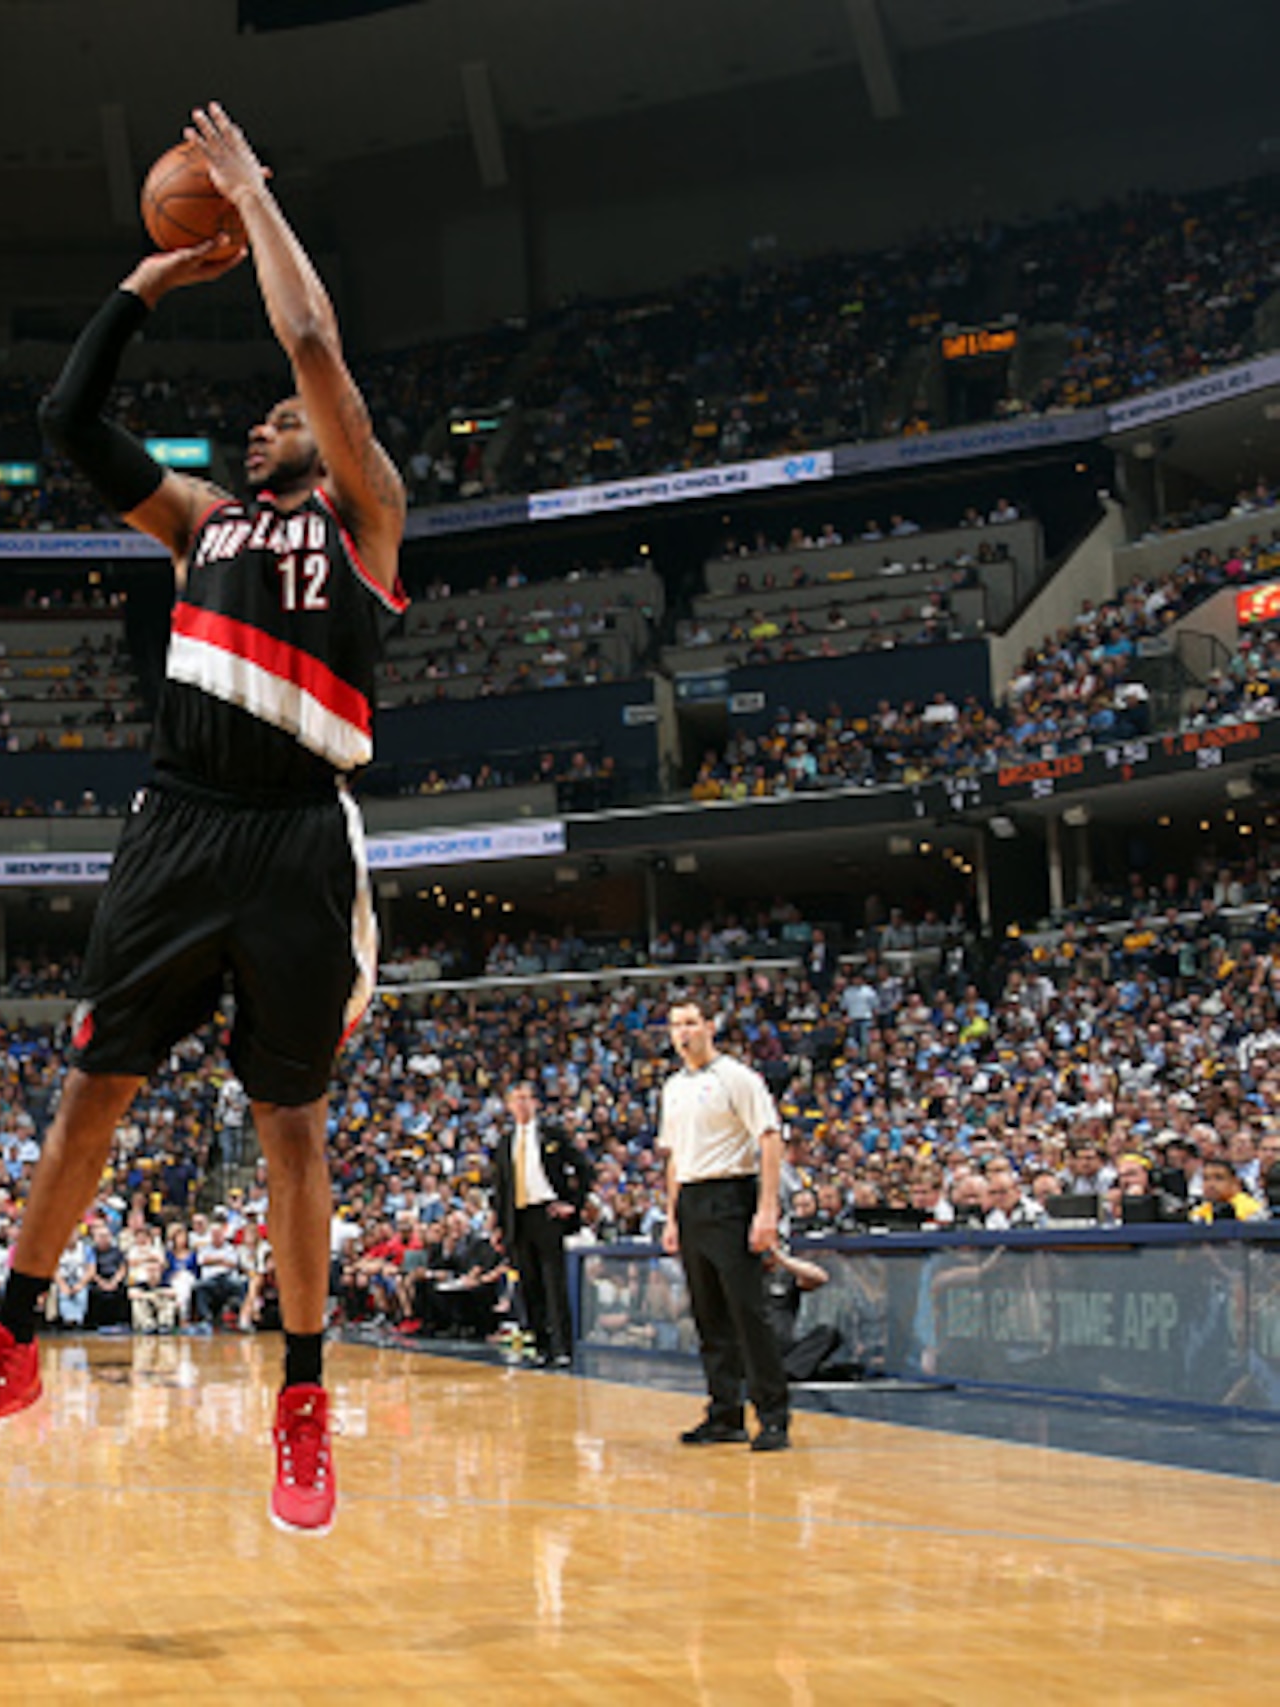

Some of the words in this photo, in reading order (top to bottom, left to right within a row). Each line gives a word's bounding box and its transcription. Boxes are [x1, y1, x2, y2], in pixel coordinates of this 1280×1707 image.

[277, 552, 330, 611] 12
[392, 836, 492, 859] SUPPORTER
[3, 861, 82, 876] MEMPHIS
[1058, 1291, 1115, 1346] TIME
[1123, 1291, 1178, 1350] APP
